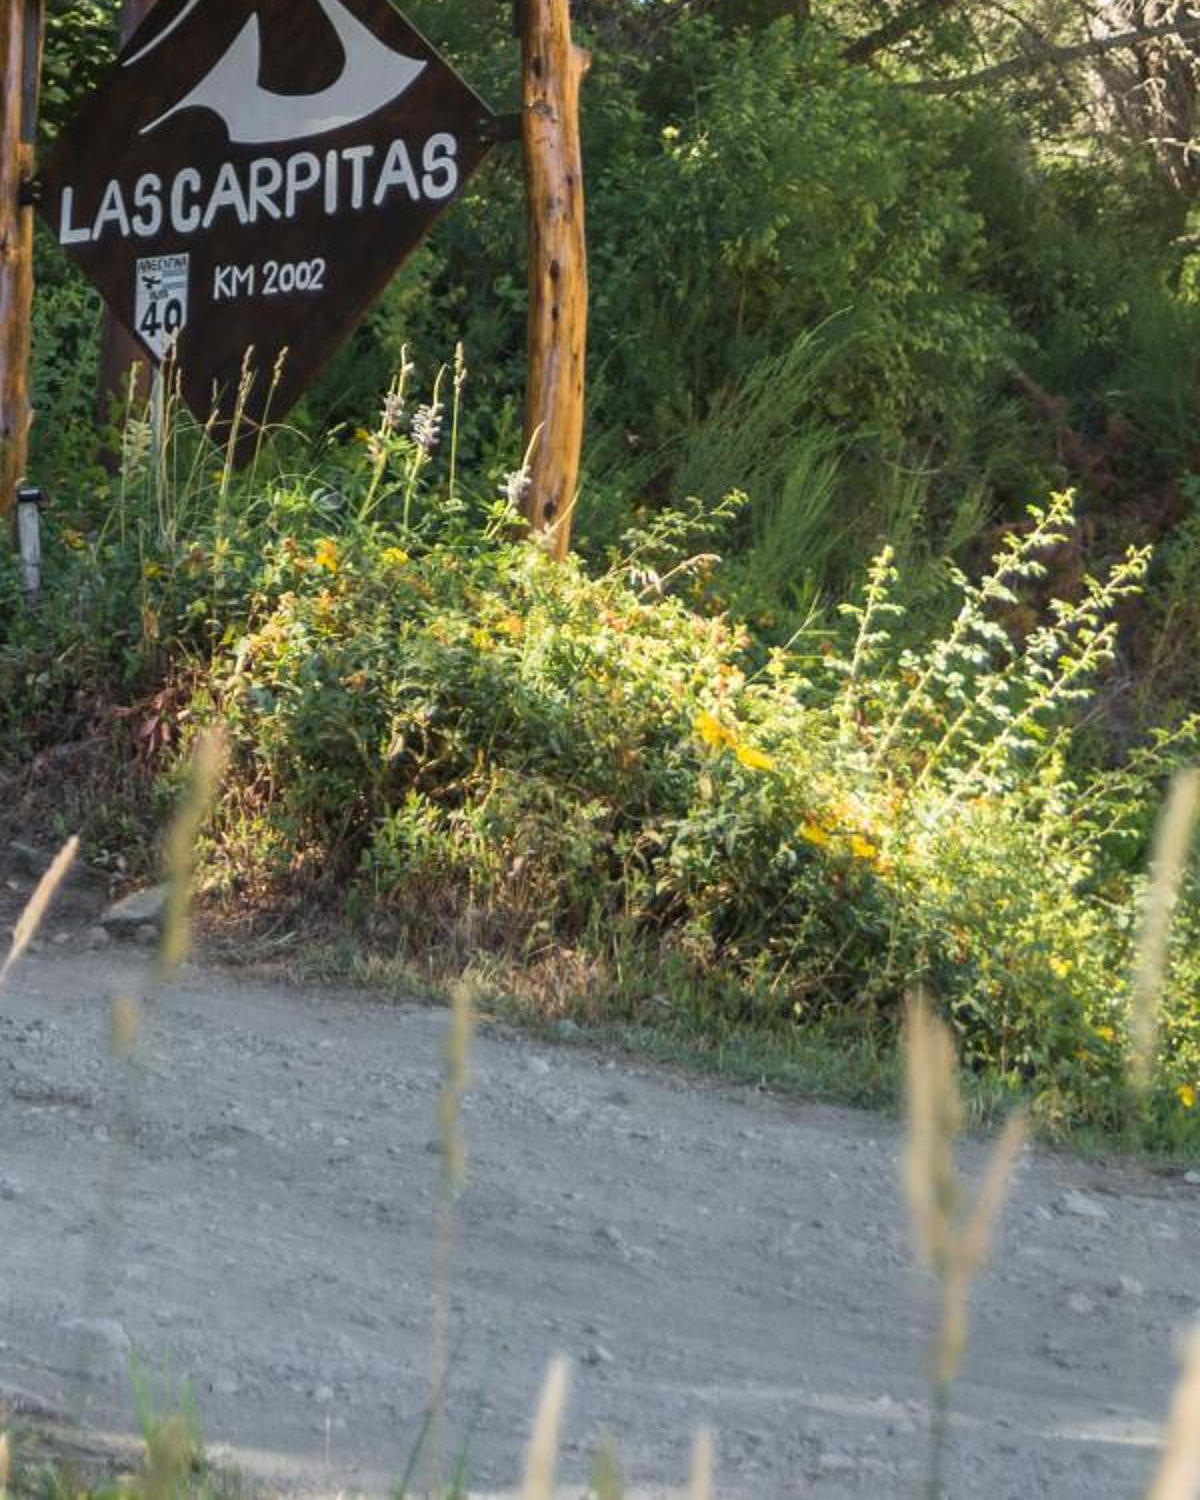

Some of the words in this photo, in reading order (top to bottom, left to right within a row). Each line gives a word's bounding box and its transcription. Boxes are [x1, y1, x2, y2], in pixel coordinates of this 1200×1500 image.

[59, 172, 162, 244] LAS
[171, 132, 458, 234] CARPITAS
[213, 264, 254, 300] KM
[262, 258, 325, 294] 2002
[141, 298, 182, 336] 40
